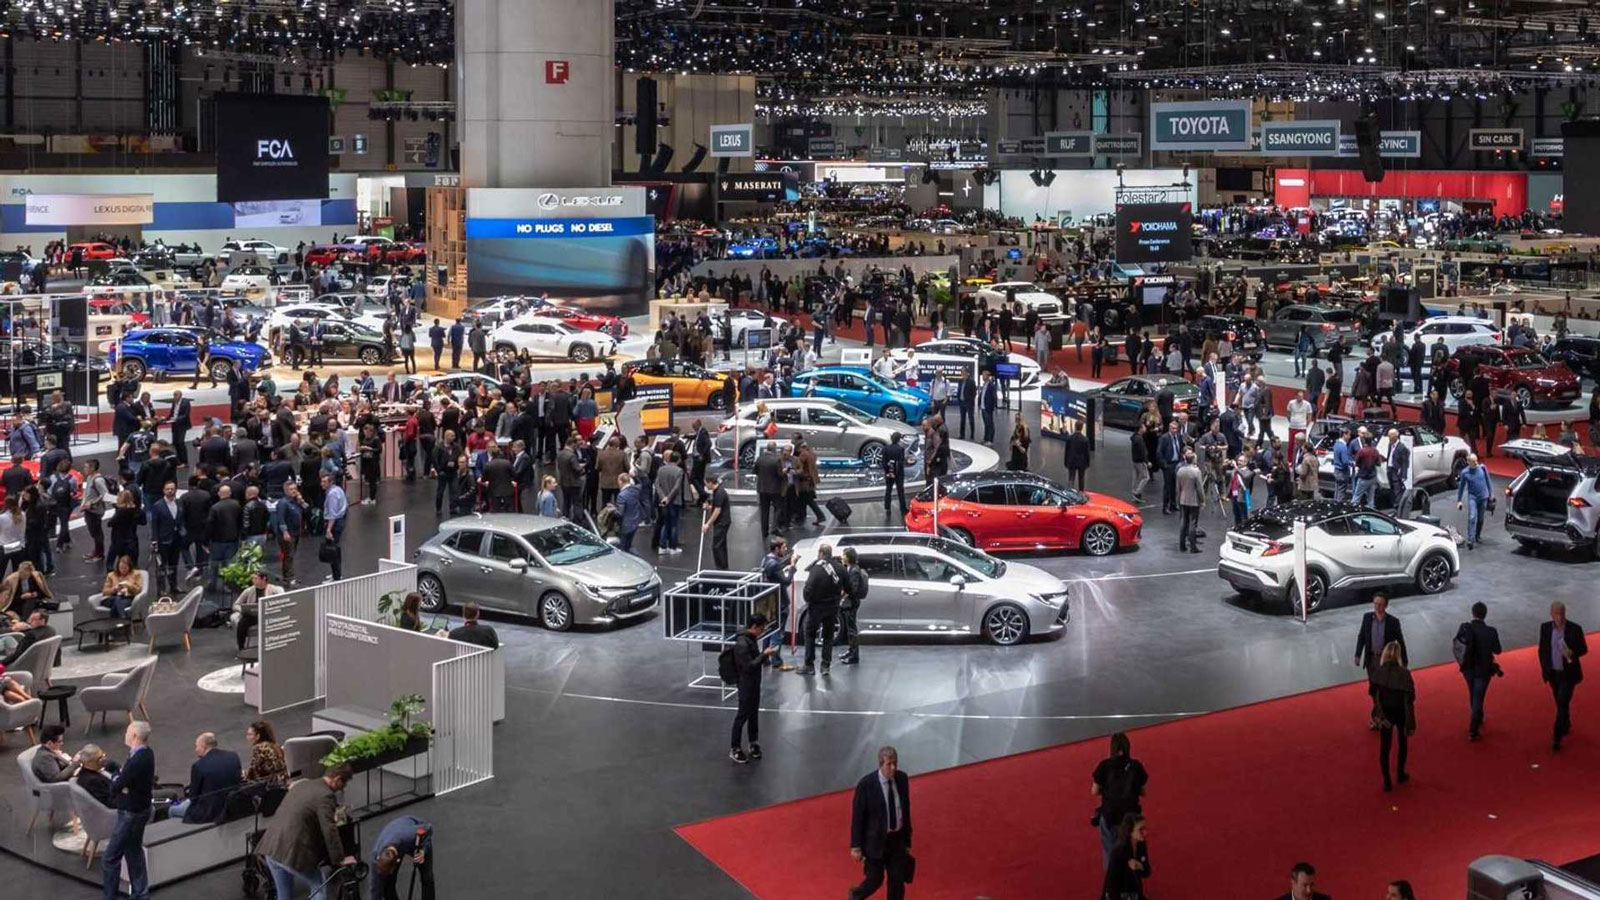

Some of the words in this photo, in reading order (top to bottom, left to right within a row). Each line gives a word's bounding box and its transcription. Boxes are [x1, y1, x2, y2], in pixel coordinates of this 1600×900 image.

[553, 63, 564, 79] F
[1169, 116, 1230, 135] TOYOTA
[720, 135, 741, 147] LEXUS
[1268, 132, 1331, 145] SSANGYONG
[257, 140, 293, 158] FCA
[1060, 139, 1076, 149] RUF
[1379, 139, 1408, 149] EVINCI
[735, 181, 780, 190] MASERATI
[562, 196, 623, 206] LEXUS
[1116, 192, 1158, 204] Polestar
[1160, 191, 1167, 203] 2
[94, 205, 121, 213] LEXUS
[517, 224, 533, 233] NO
[535, 224, 564, 233] PLUGS
[571, 223, 586, 232] NO
[589, 223, 614, 232] DIESEL
[1141, 222, 1177, 231] YOKOHAMA
[1144, 275, 1174, 284] YOKOHAMA
